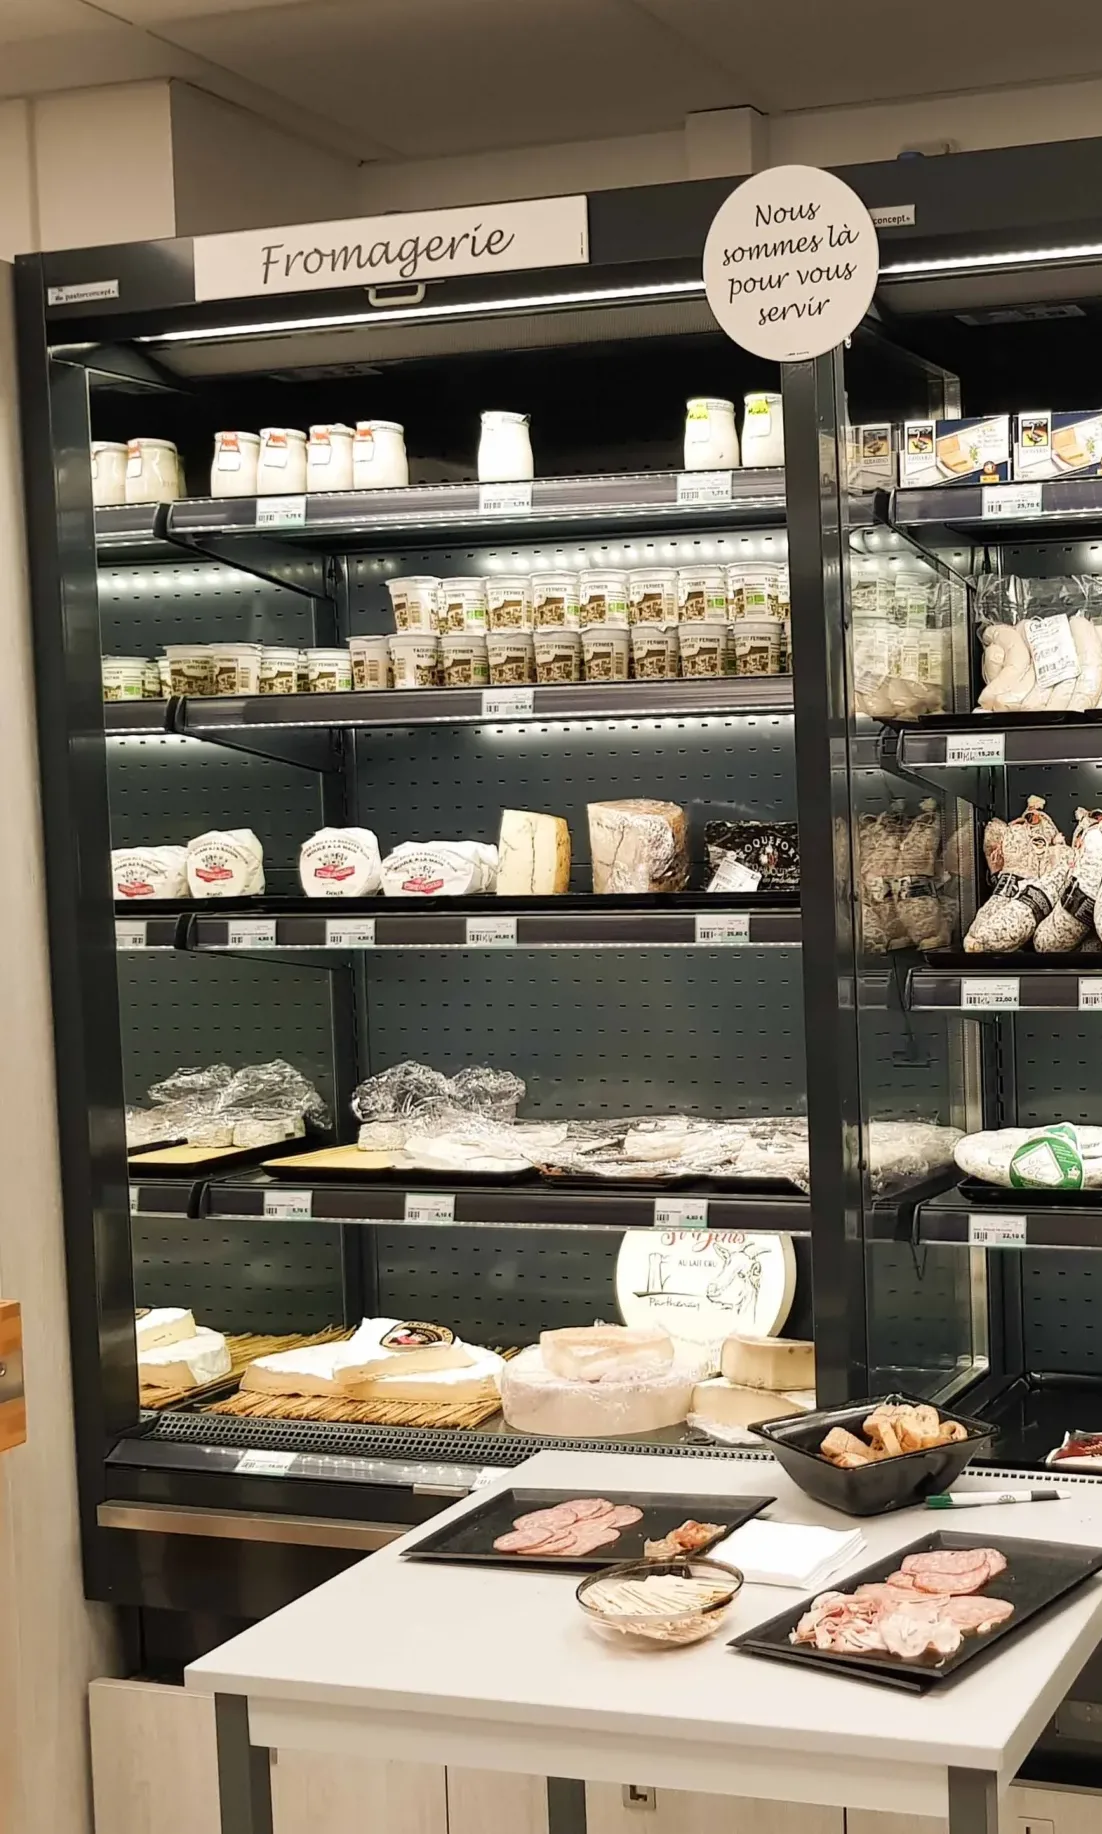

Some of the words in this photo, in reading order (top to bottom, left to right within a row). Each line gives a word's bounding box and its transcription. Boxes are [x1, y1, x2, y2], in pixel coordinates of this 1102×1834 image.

[754, 202, 821, 227] Nous
[260, 222, 515, 284] Fromagerie
[722, 235, 824, 266] sommes
[827, 223, 859, 248] là
[727, 271, 790, 304] pour
[796, 261, 857, 285] vous
[758, 296, 830, 326] servir
